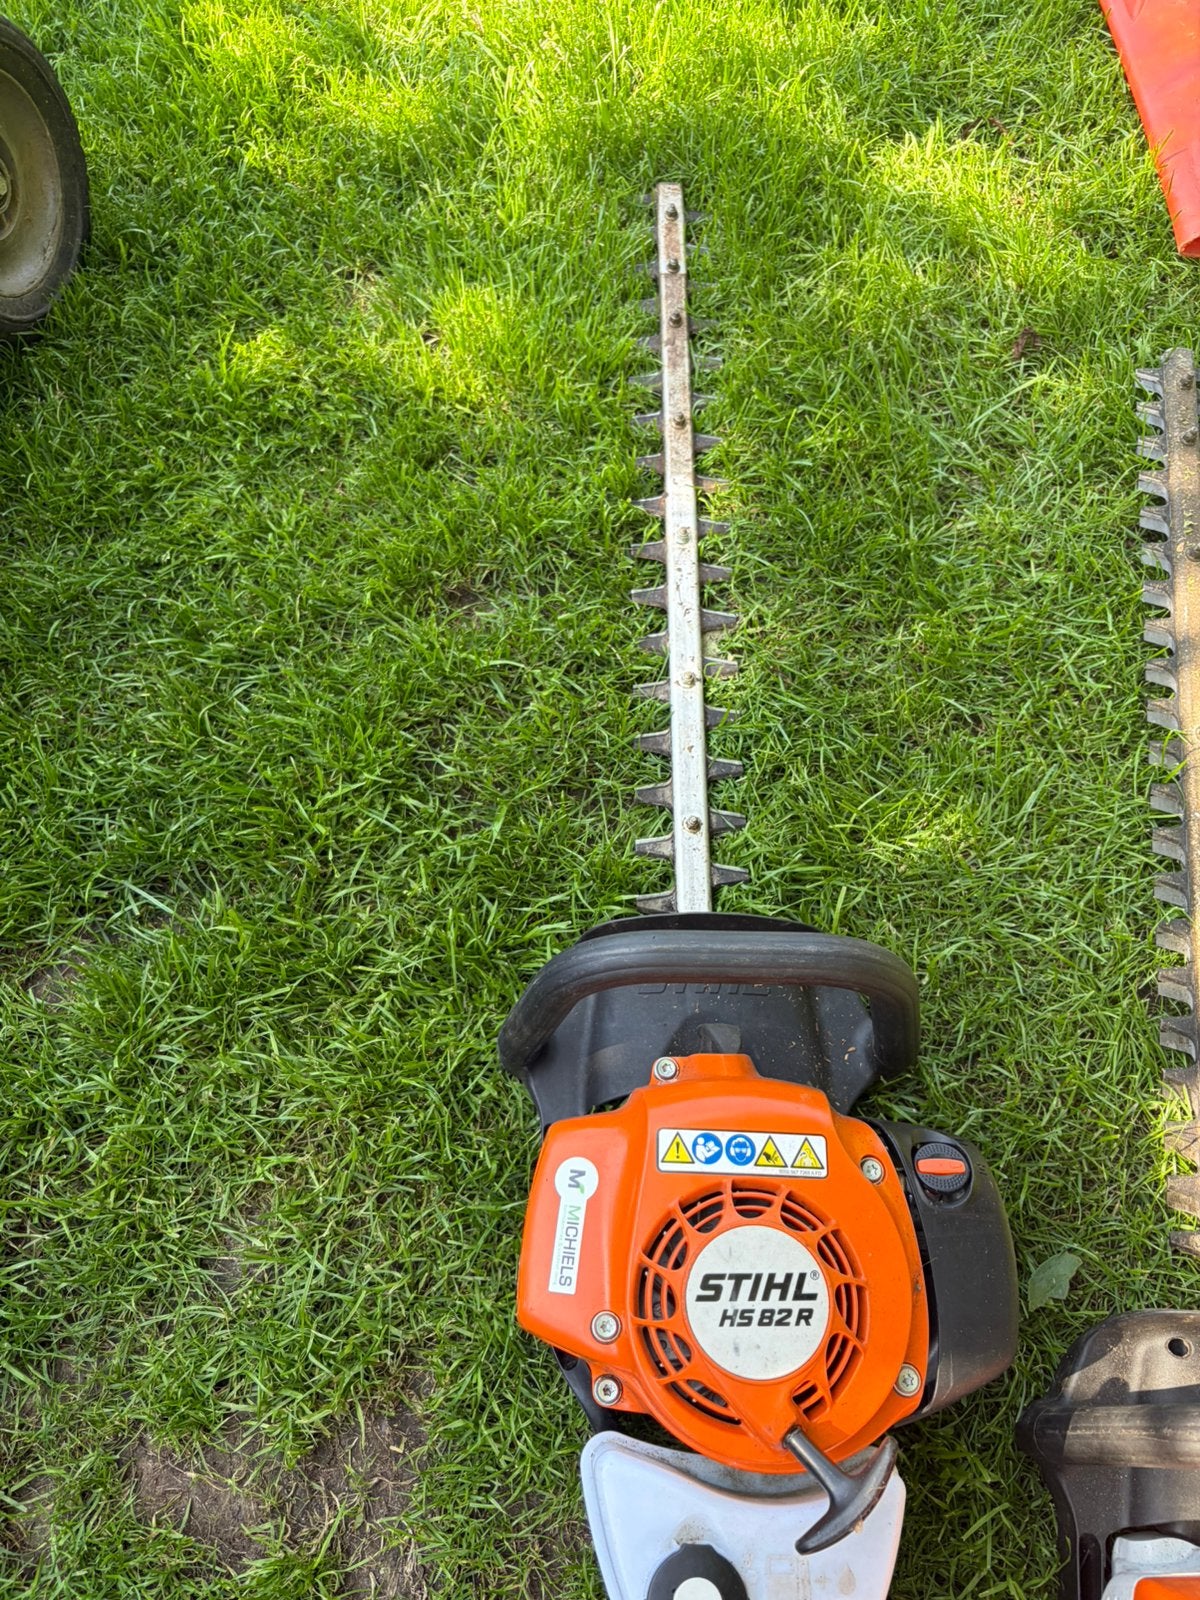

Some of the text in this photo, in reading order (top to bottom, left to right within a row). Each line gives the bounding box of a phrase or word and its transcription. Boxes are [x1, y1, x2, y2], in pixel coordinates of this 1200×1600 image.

[558, 1204, 582, 1287] MICHIELS
[719, 1308, 814, 1327] HS 82 R
